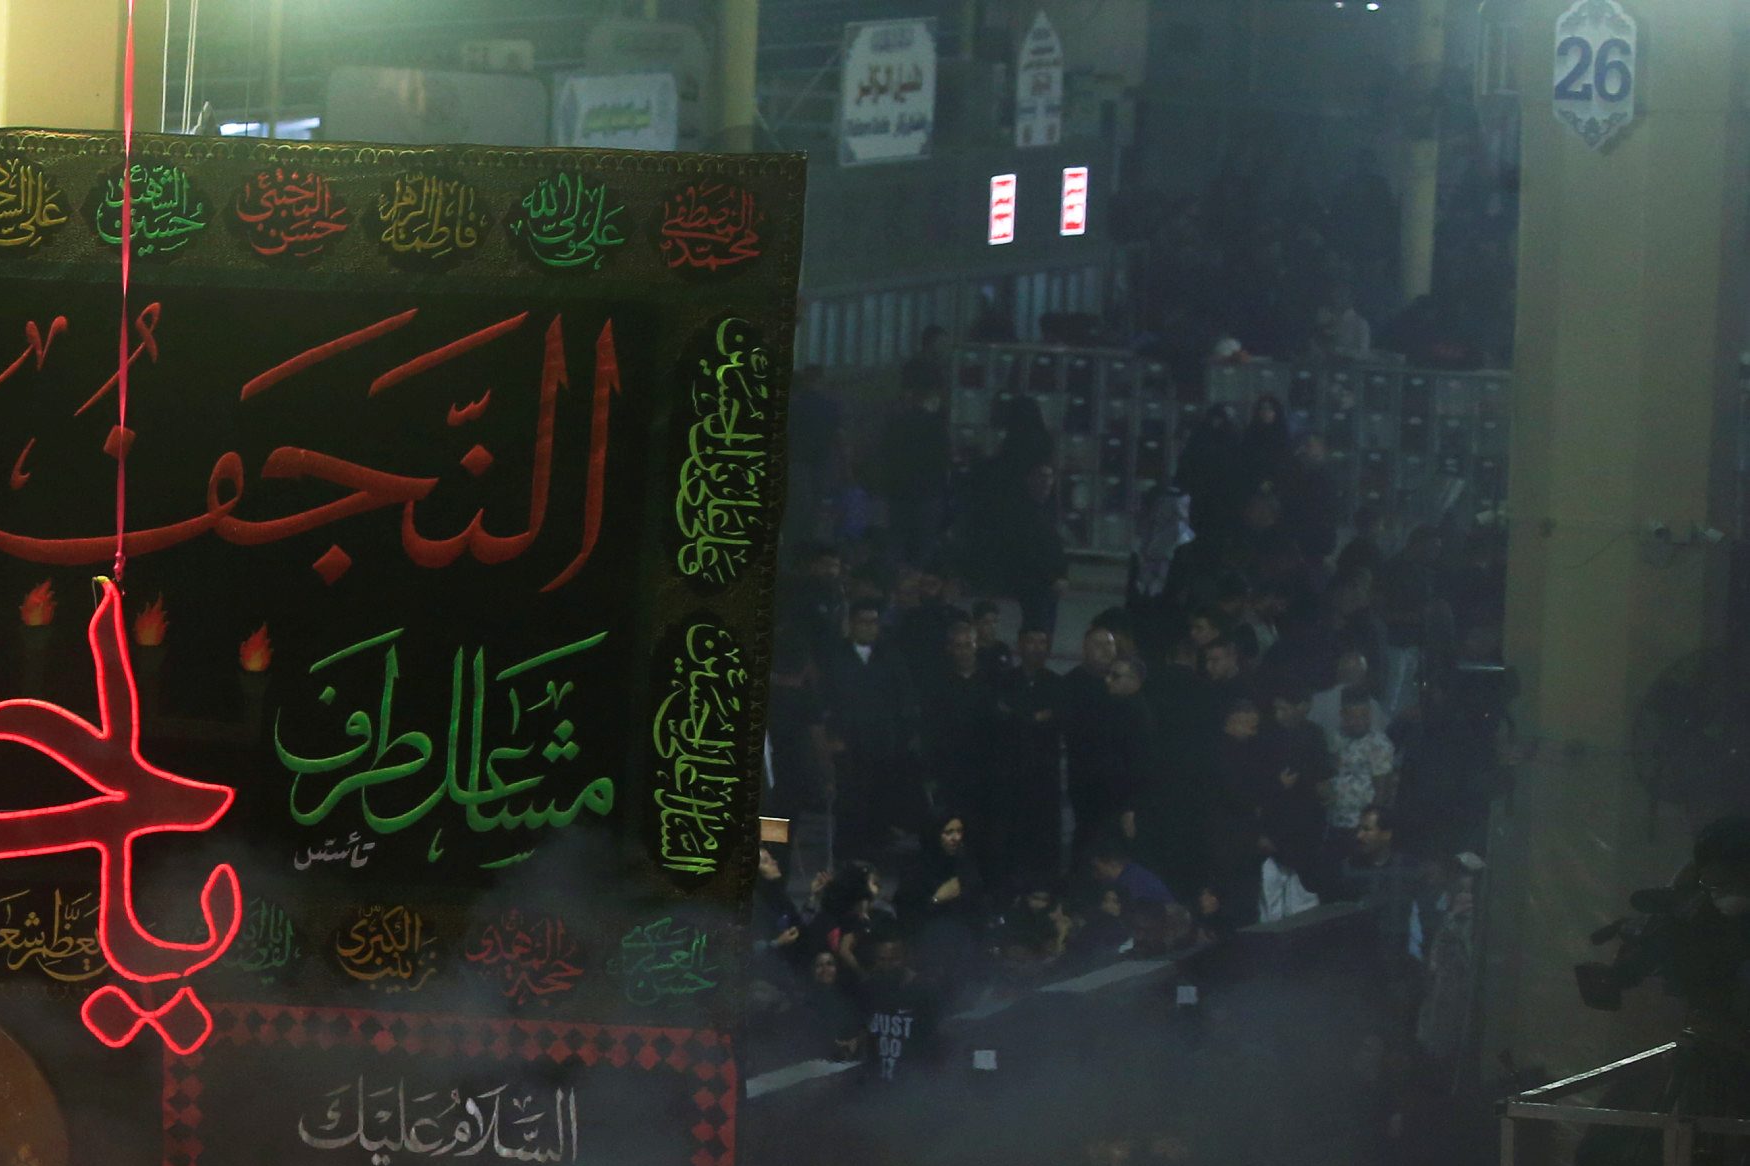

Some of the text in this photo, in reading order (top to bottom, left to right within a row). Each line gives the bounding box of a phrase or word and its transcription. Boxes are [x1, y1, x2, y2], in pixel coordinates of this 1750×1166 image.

[1554, 36, 1632, 103] 26
[869, 1012, 914, 1039] JUST
[878, 1036, 902, 1058] DO
